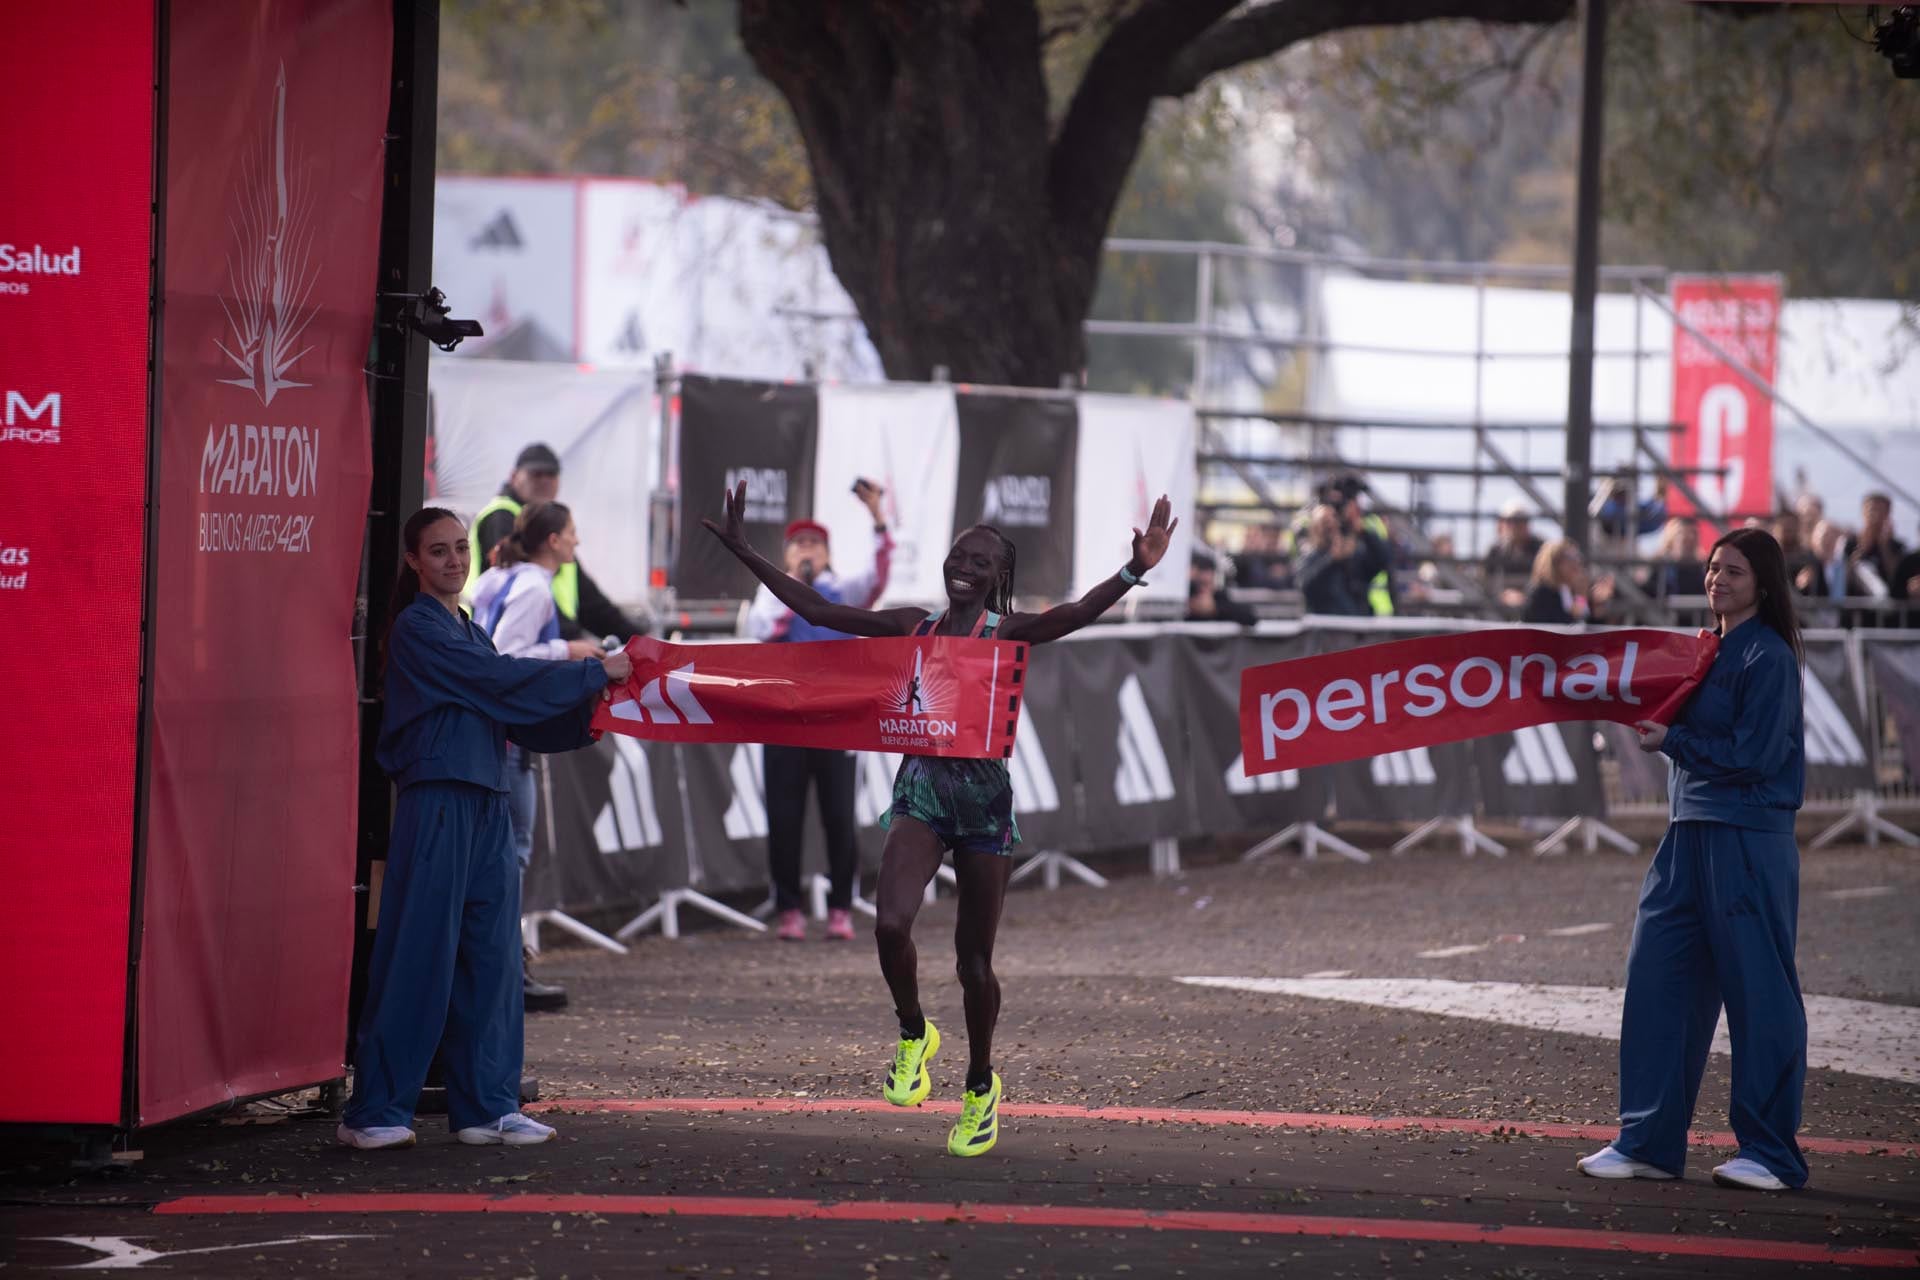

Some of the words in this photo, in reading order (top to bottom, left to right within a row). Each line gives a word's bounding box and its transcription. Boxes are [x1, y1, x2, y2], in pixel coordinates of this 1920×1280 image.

[0, 244, 80, 275] Salud
[200, 423, 319, 498] MARATON
[200, 512, 242, 552] BUENOS
[0, 541, 29, 566] as
[0, 571, 28, 589] ud
[1260, 641, 1641, 761] personal
[879, 719, 957, 737] MARATON
[881, 735, 909, 746] BUENOS
[910, 737, 929, 747] AIRES
